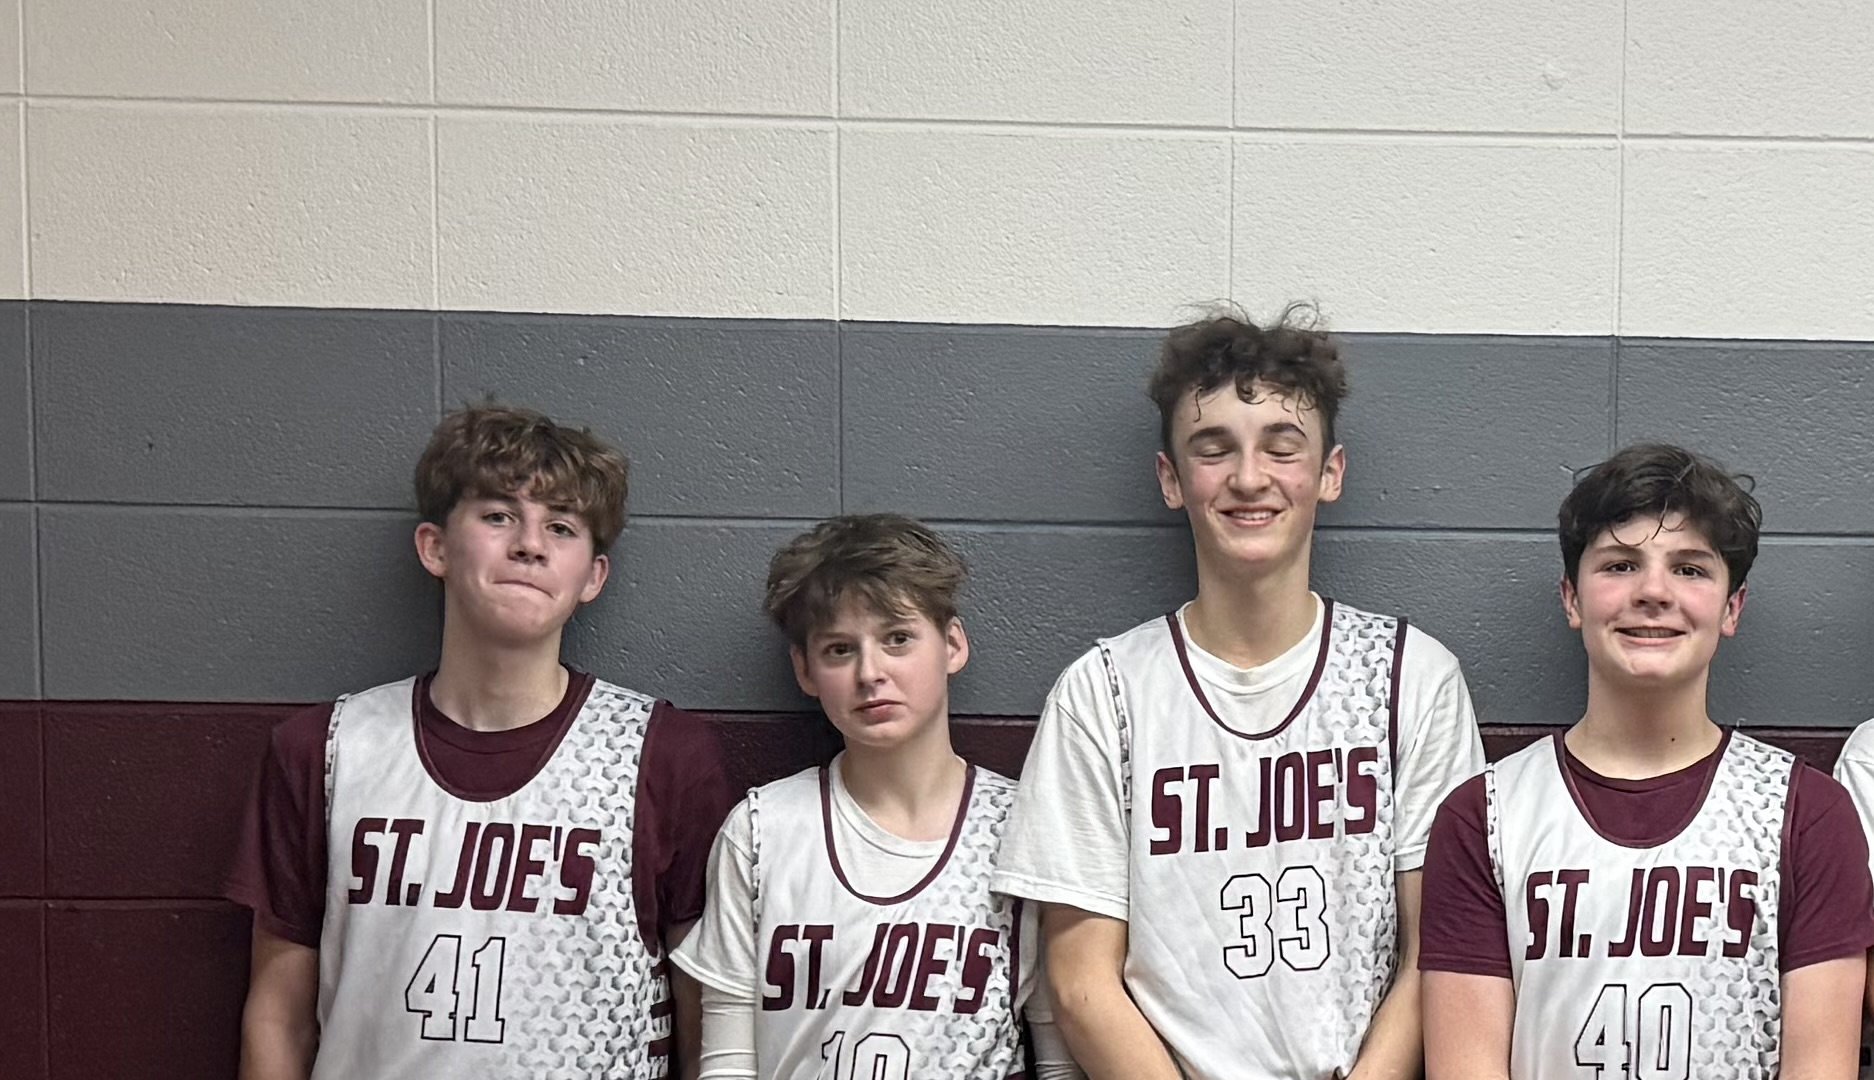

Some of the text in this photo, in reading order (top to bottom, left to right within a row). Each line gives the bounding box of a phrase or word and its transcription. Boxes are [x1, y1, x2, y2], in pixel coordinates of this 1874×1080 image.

[1150, 747, 1379, 855] ST. JOE'S
[348, 817, 602, 917] ST. JOE'S
[1525, 866, 1758, 960] ST. JOE'S
[842, 922, 1000, 1014] JOE'S
[1220, 865, 1330, 980] 33
[405, 934, 506, 1044] 41
